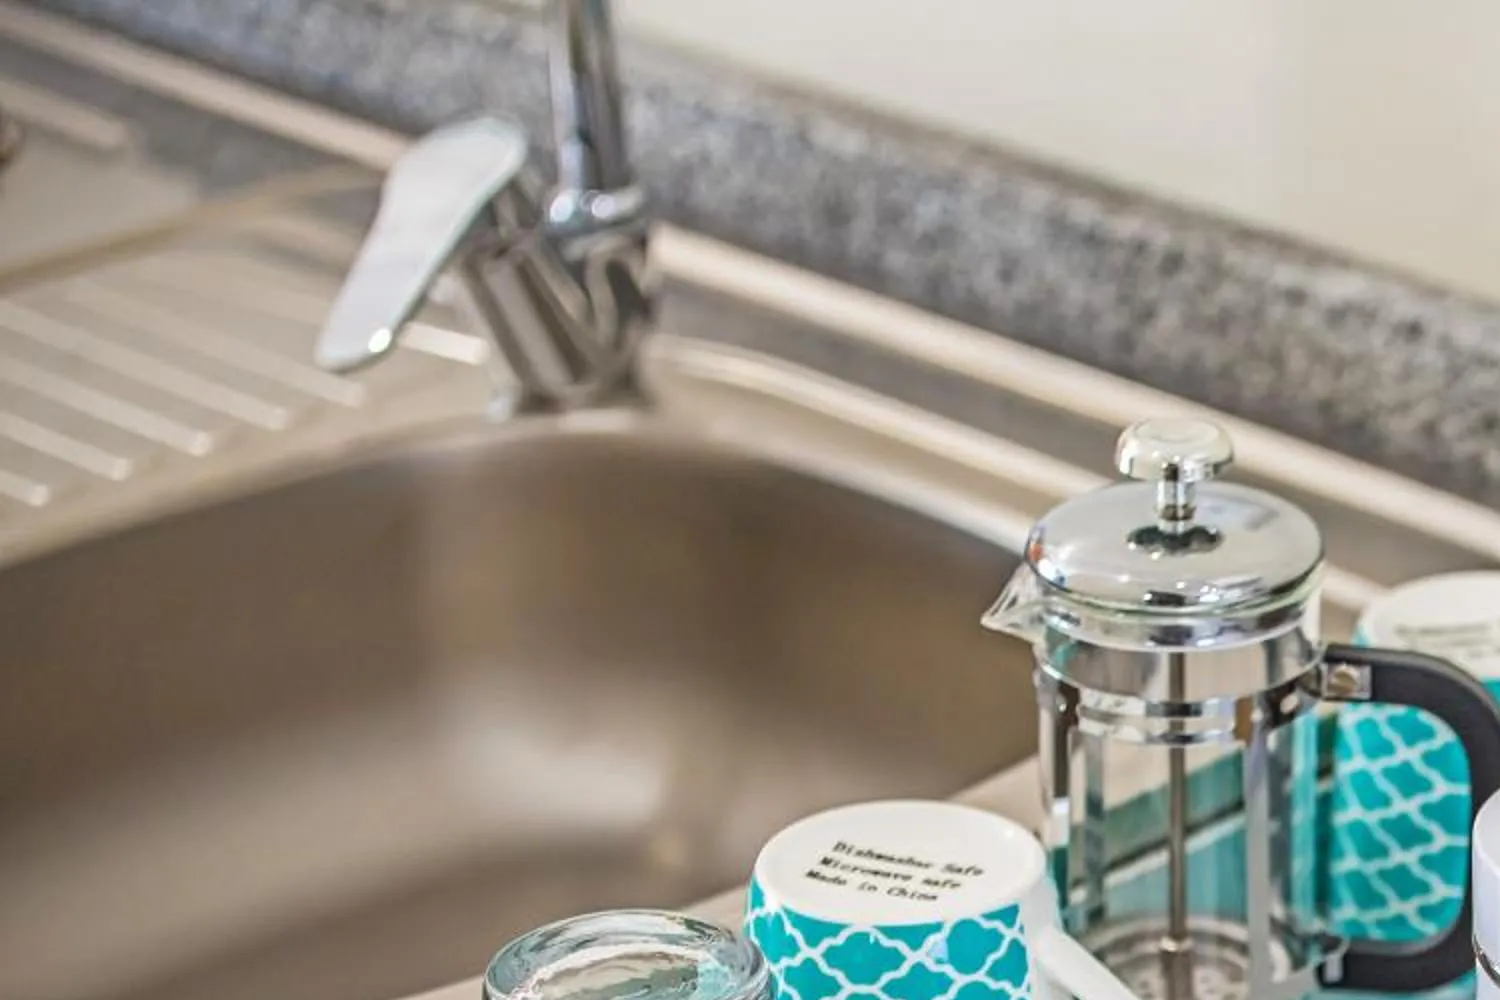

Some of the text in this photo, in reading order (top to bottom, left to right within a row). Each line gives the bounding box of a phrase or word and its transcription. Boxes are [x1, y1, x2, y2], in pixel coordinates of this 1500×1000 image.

[820, 857, 912, 881] Microwave
[806, 870, 938, 901] Made in China
